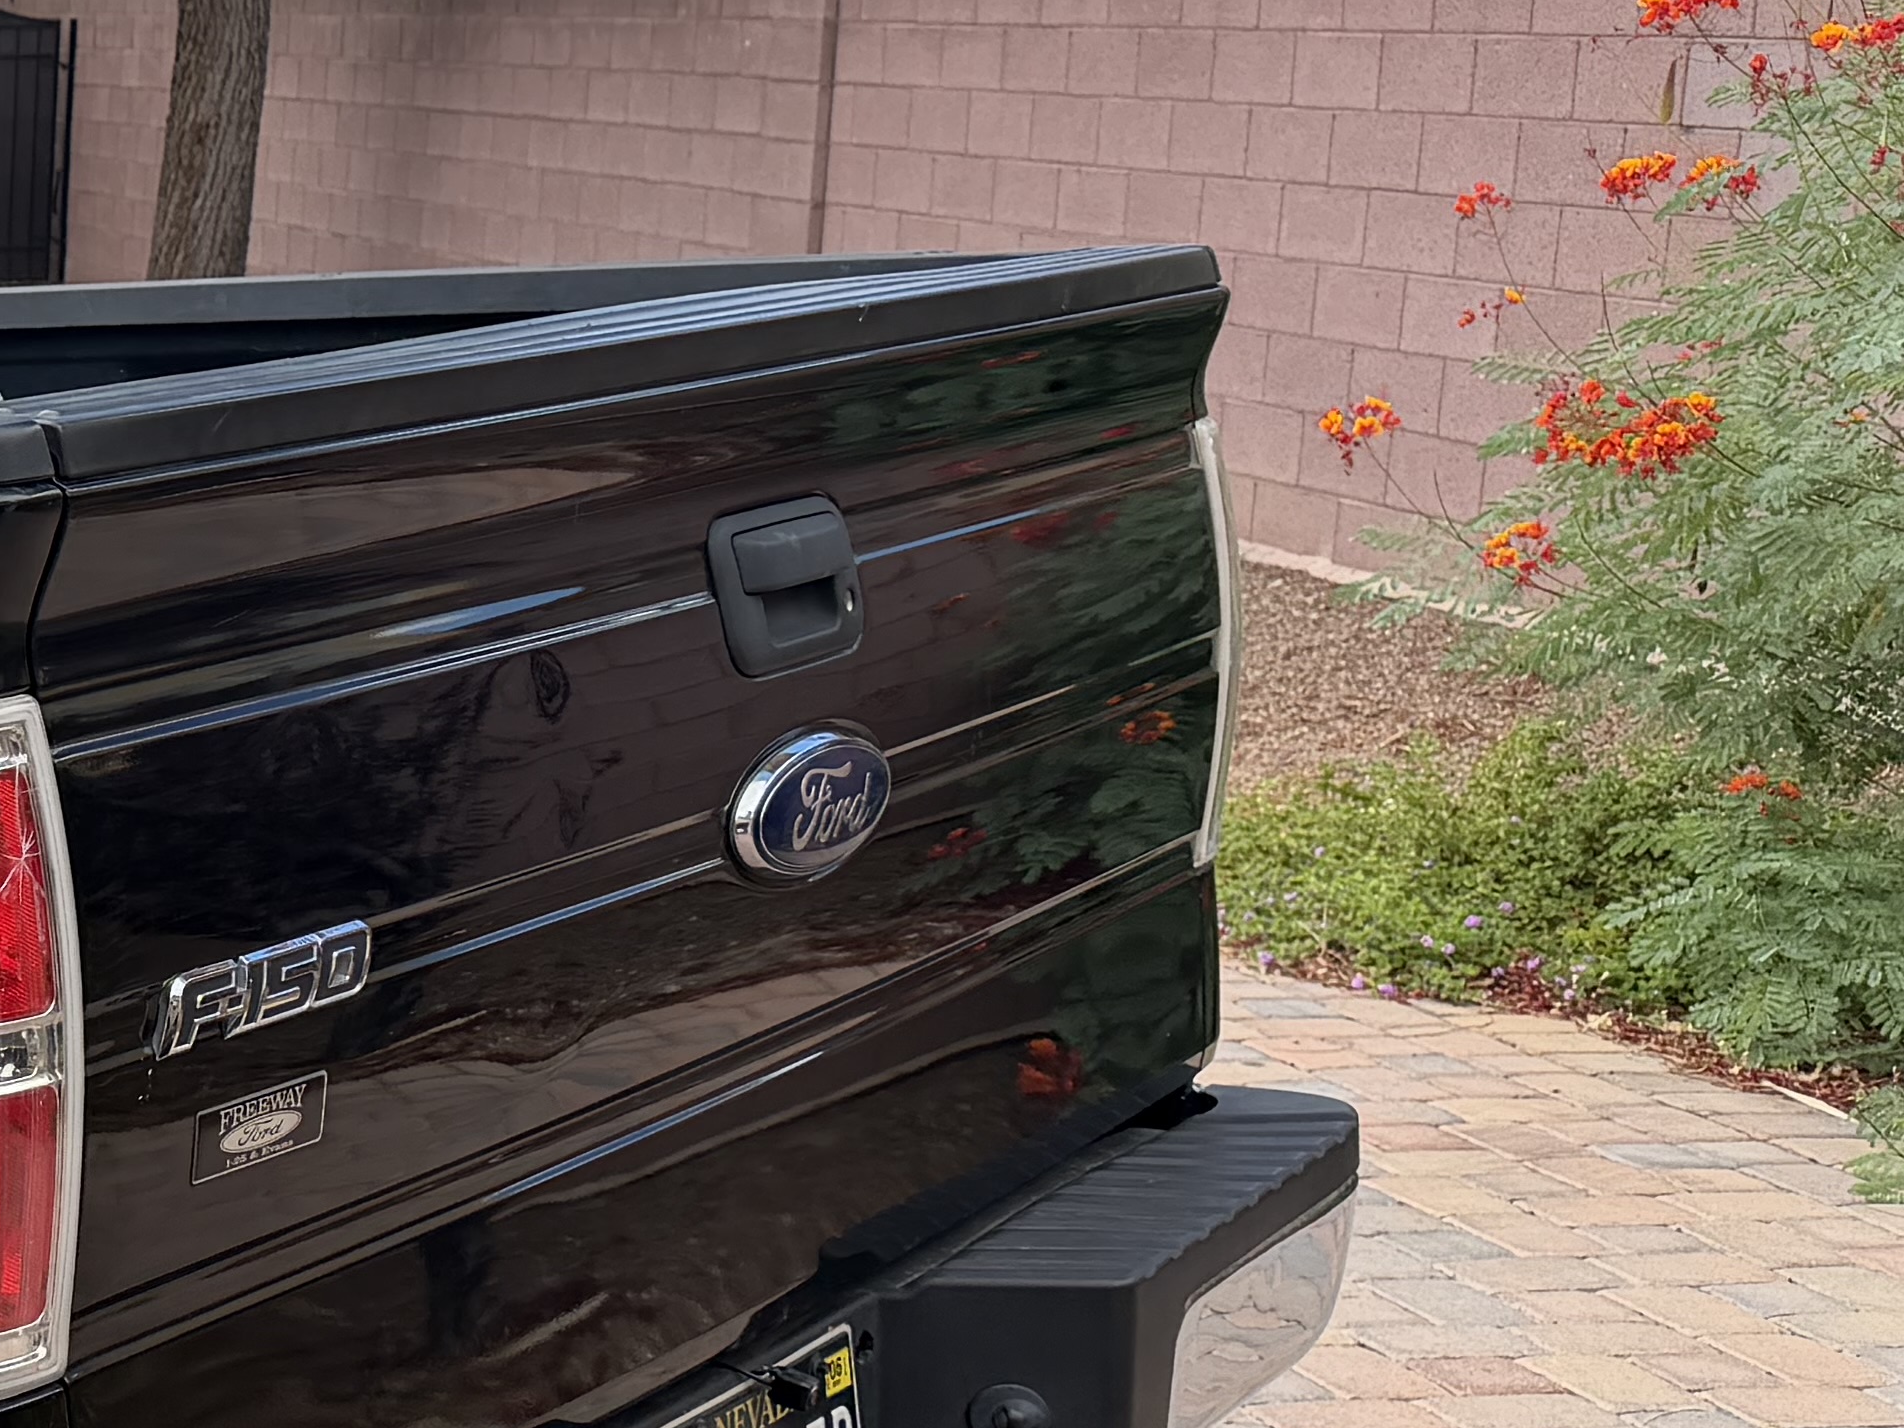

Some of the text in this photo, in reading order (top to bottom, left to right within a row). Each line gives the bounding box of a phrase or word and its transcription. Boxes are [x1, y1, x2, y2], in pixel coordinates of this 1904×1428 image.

[792, 760, 873, 853] Ford
[151, 919, 372, 1061] F-150
[218, 1083, 307, 1136] FREEWAY
[238, 1117, 284, 1147] Ford
